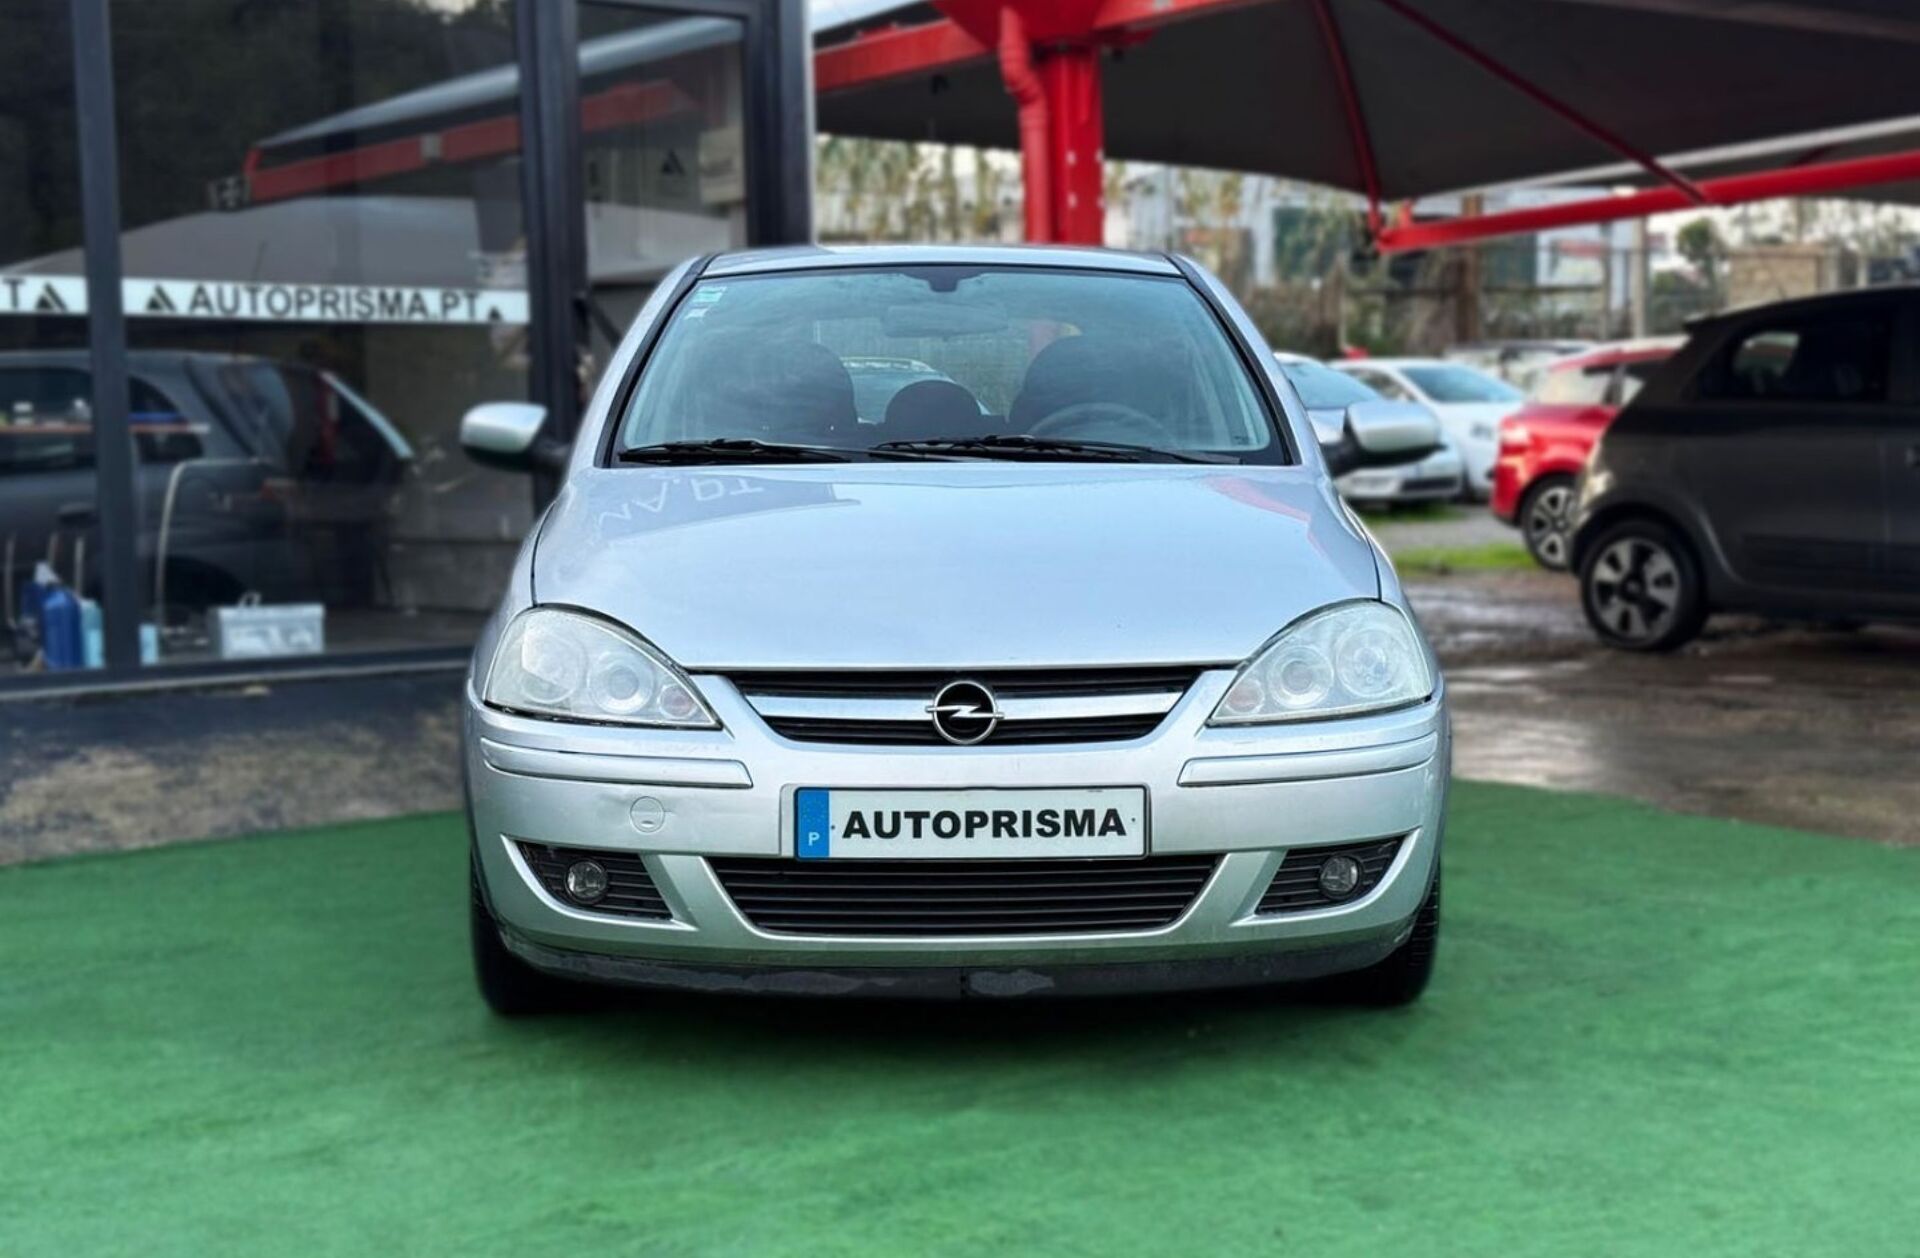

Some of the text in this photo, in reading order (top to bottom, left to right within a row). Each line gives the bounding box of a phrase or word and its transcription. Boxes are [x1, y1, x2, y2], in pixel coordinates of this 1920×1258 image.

[189, 283, 480, 321] AUTOPRISMA.PT
[808, 808, 1127, 847] P AUTOPRISMA
